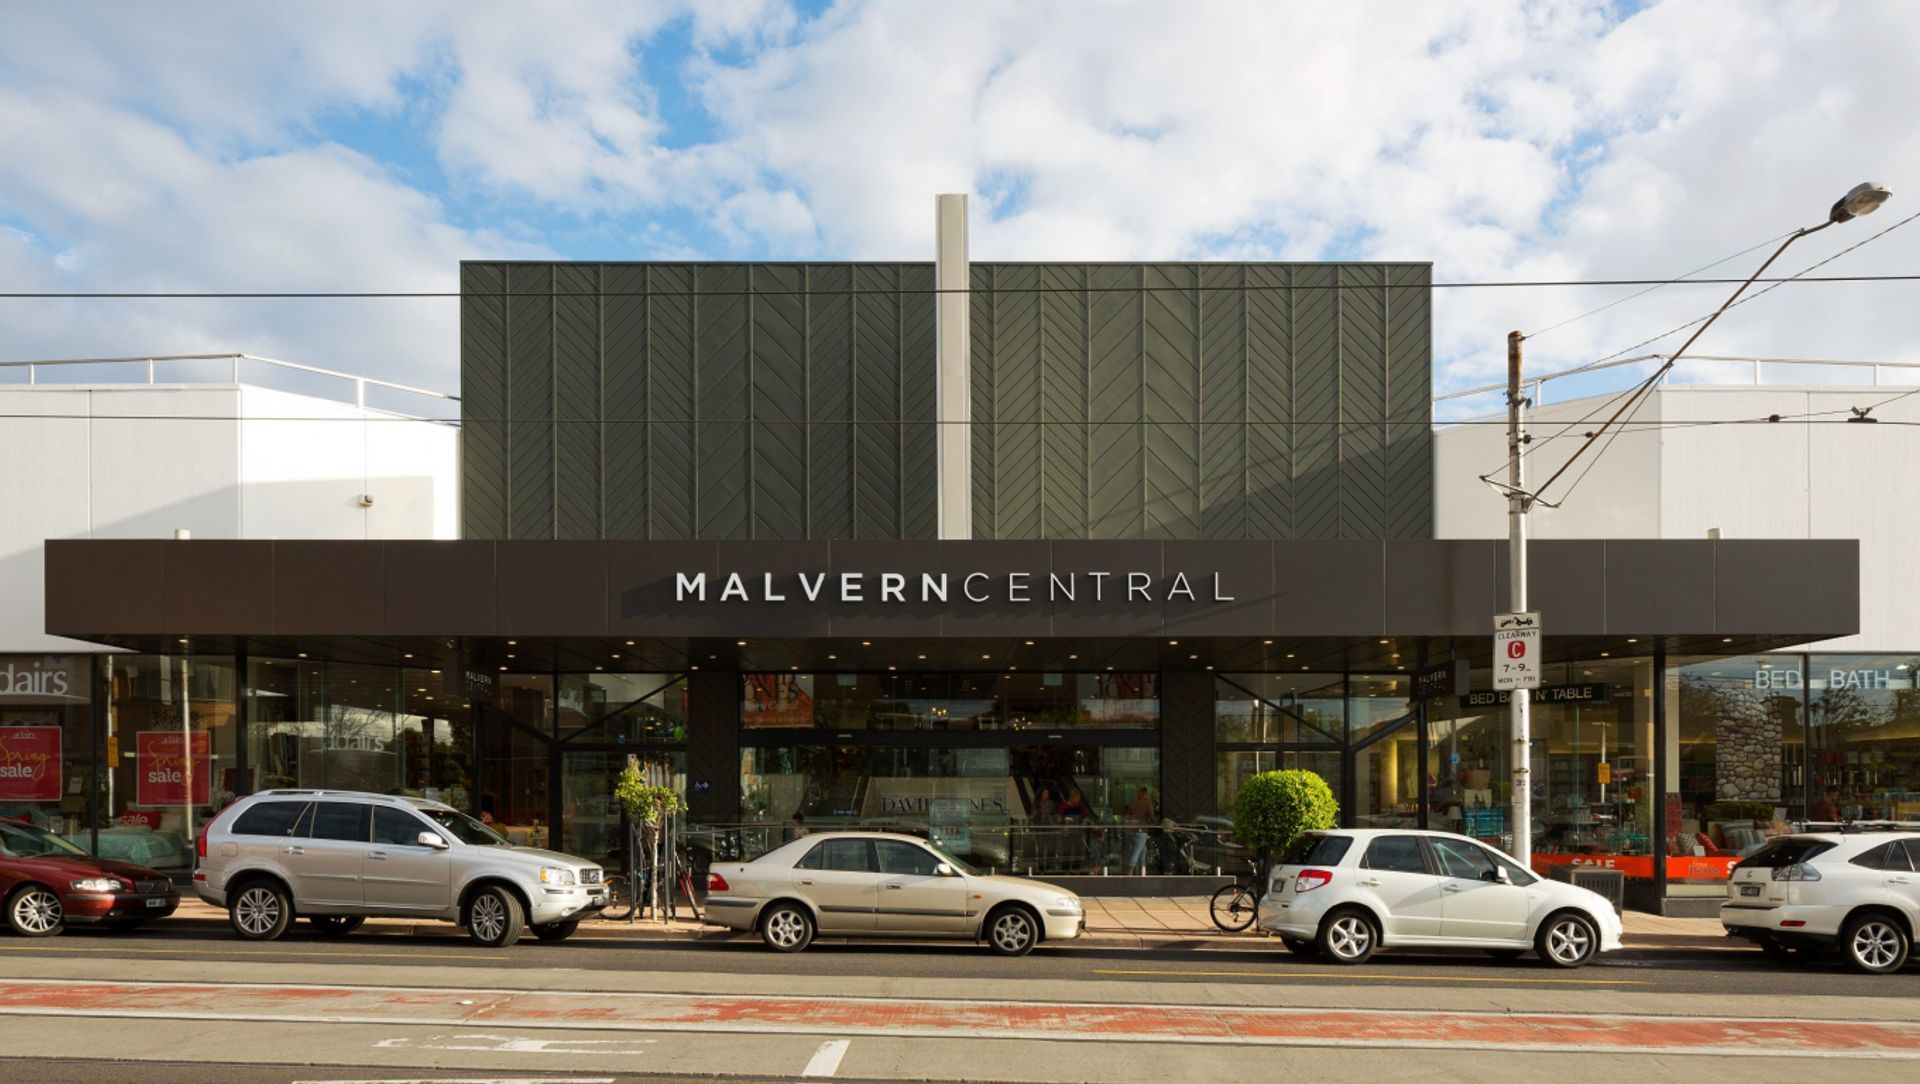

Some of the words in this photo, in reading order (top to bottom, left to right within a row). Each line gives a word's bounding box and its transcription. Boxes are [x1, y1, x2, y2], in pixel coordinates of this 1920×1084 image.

[1497, 631, 1536, 640] CLEARWAY
[0, 662, 69, 695] dairs
[1755, 670, 1801, 689] BED
[1830, 670, 1890, 689] BATH
[1469, 693, 1495, 705] BED
[1552, 687, 1593, 700] TABLE
[0, 763, 33, 777] sale
[148, 768, 181, 783] sale
[121, 813, 149, 826] sale
